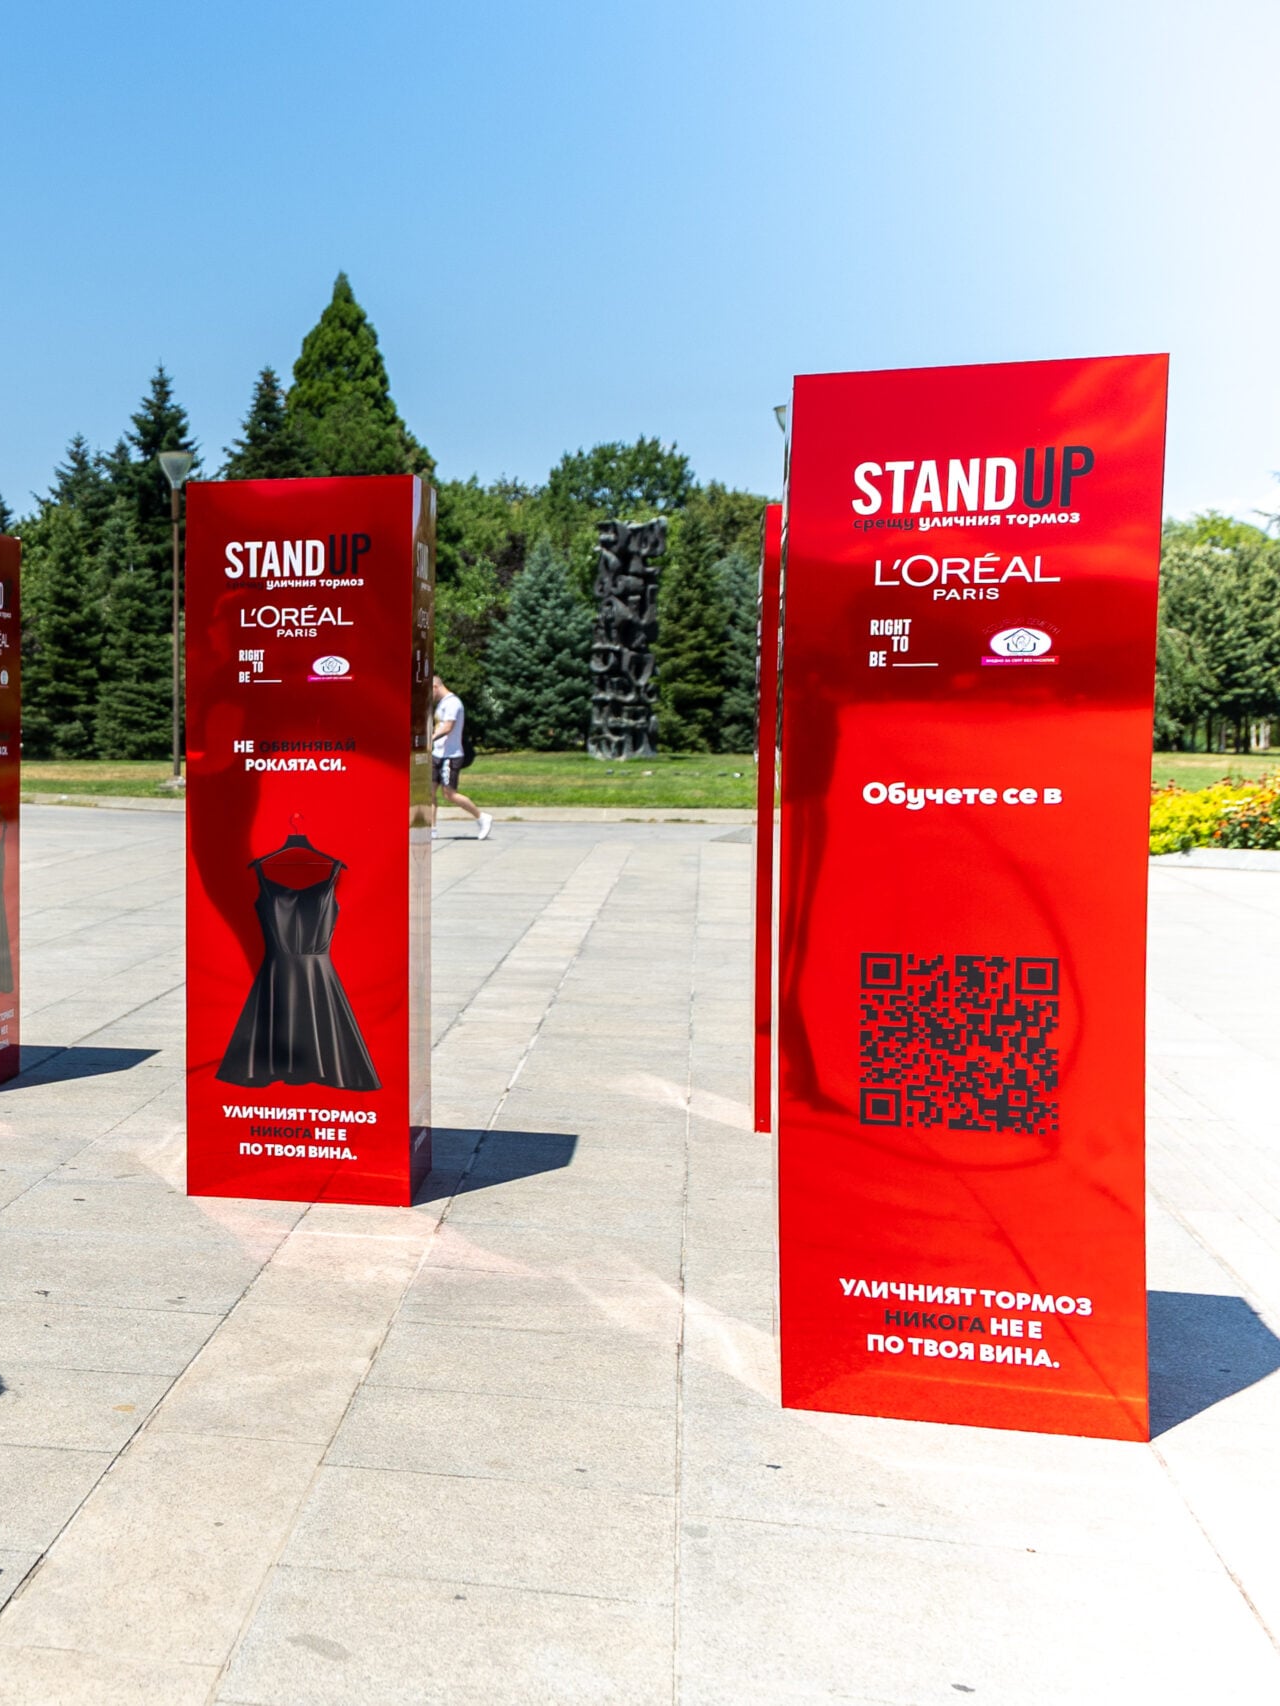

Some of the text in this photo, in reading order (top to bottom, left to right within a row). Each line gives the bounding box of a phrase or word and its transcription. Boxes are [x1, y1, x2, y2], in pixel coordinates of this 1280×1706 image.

[853, 512, 1080, 533] срещу уличния тормоз
[874, 553, 1061, 587] L'ORÉAL
[266, 580, 317, 590] уличния
[319, 578, 364, 589] тормоз
[240, 604, 353, 628] L'ORÉAL
[870, 618, 912, 636] RIGHT
[891, 636, 909, 652] TO
[239, 650, 265, 661] RIGHT
[869, 651, 887, 667] BE
[253, 661, 263, 673] TO
[239, 672, 250, 683] BE
[233, 738, 356, 753] НЕ ОБВИНЯВАЙ
[245, 758, 346, 771] РОКЛЯТА СИ.
[862, 781, 1062, 811] Обучете се в
[222, 1105, 377, 1124] УЛИЧНИЯТ ТОРМОЗ
[250, 1125, 347, 1141] НИКОГА НЕ Е
[239, 1142, 357, 1160] ПО ТВОЯ ВИНА.
[839, 1277, 1092, 1317] УЛИЧНИЯТ ТОРМОЗ
[884, 1308, 1042, 1339] НИКОГА НЕ Е
[866, 1333, 1060, 1368] ПО ТВОЯ ВИНА.
